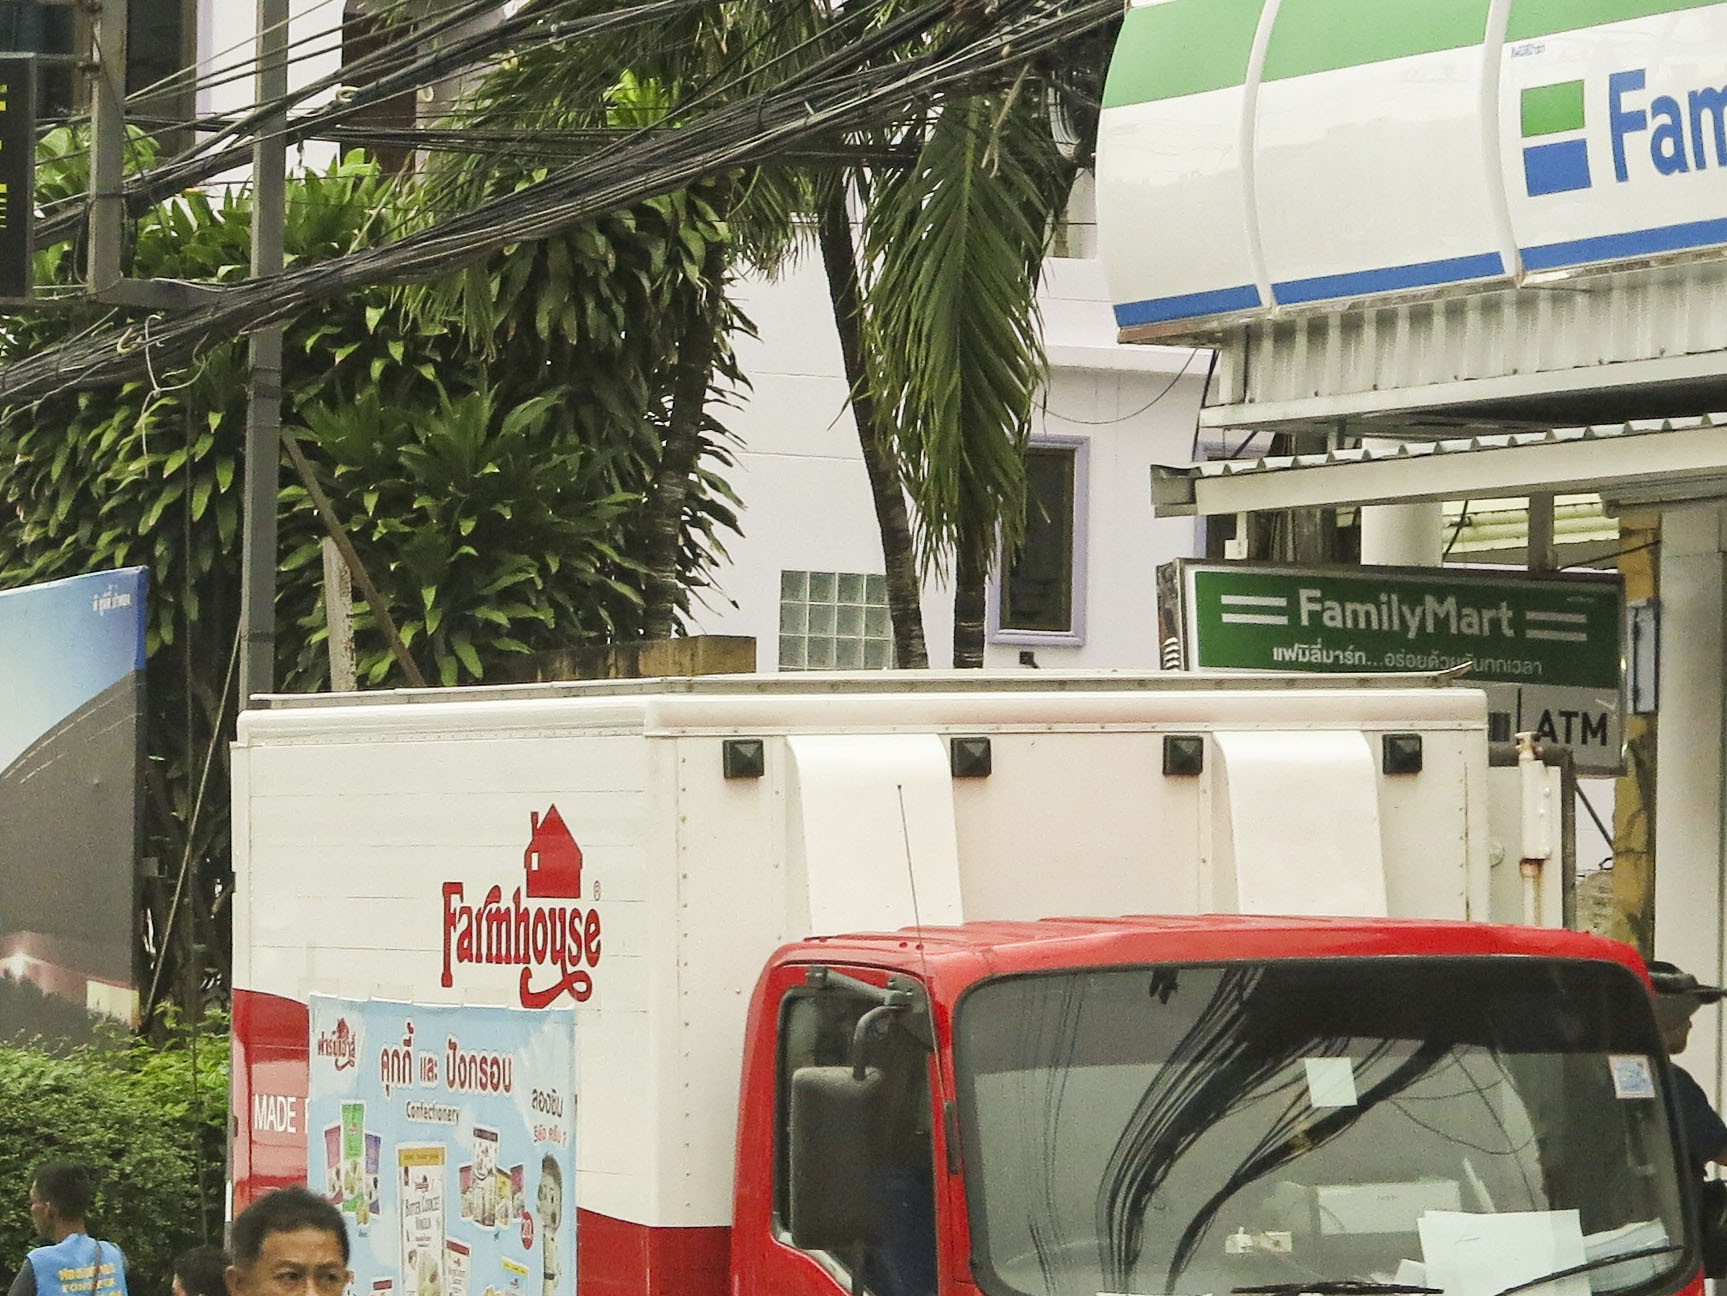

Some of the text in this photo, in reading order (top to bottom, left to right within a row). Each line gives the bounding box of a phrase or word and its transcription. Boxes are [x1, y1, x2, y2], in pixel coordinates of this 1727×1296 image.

[1298, 588, 1515, 639] FamilyMart
[1537, 711, 1608, 746] ATM
[441, 881, 602, 1009] Farmhouse
[381, 1022, 414, 1097] คุกกี้
[420, 1055, 438, 1082] และ
[254, 1093, 297, 1134] MADE
